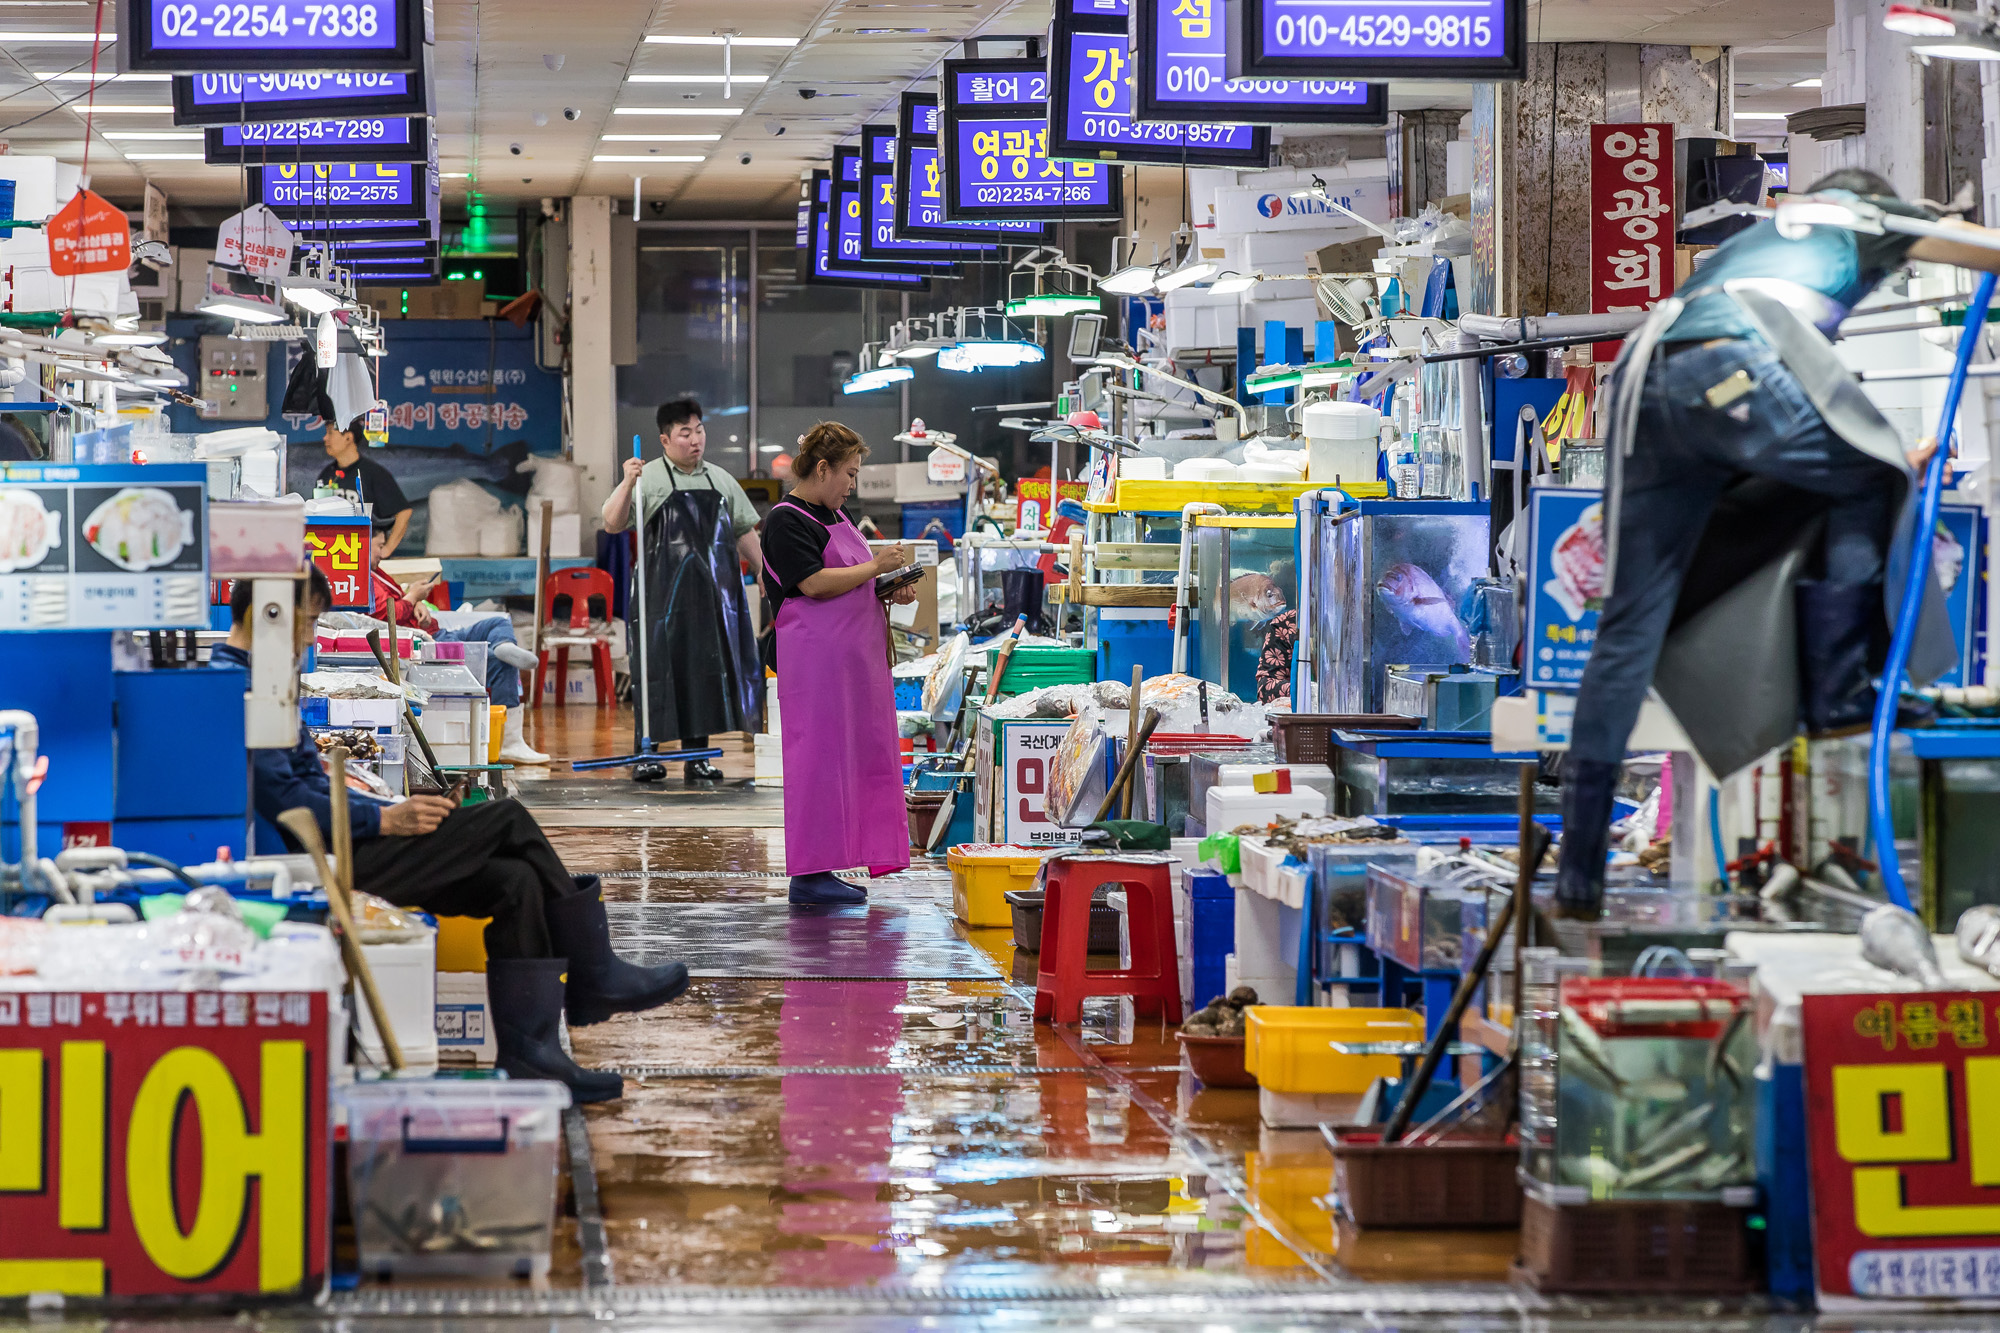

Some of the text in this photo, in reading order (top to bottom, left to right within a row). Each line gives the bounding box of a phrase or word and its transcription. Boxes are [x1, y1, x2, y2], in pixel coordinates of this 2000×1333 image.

[161, 4, 378, 37] 02-2254-7338
[1275, 15, 1491, 47] 010-4529-9815
[970, 77, 1019, 102] 활어
[1083, 48, 1131, 109] 강
[241, 120, 385, 142] 02)2254-7299
[1084, 118, 1236, 143] 010-3730-9577
[273, 185, 399, 201] 010-4502-2575
[977, 186, 1091, 204] 02)2254-7266
[1287, 194, 1353, 216] SALMAR
[1604, 127, 1670, 314] 영광회
[224, 237, 287, 259] 온누리상품권
[388, 402, 435, 430] 웨이
[1021, 481, 1058, 500] 대한민
[1020, 734, 1065, 750] 국산(계
[26, 992, 82, 1028] 별미
[104, 992, 188, 1028] 부위별
[255, 992, 310, 1028] 판매
